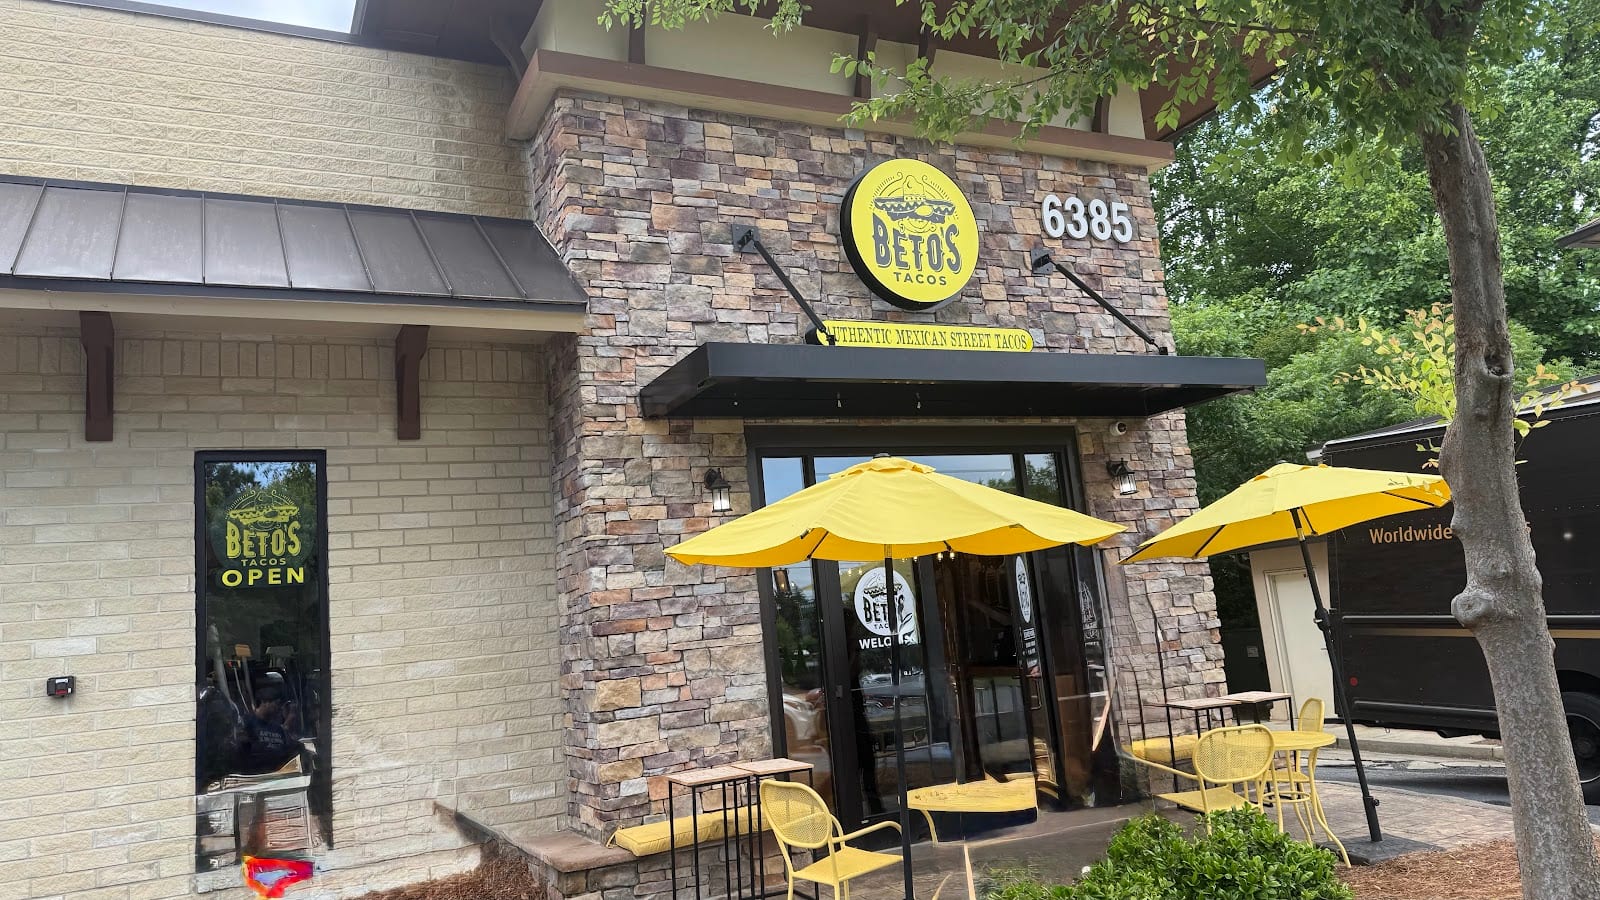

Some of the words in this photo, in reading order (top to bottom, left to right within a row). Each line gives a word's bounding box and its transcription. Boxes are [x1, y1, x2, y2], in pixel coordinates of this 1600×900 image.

[1041, 194, 1133, 244] 6385
[872, 213, 962, 275] BETO'S
[892, 271, 948, 286] TACOS
[895, 328, 947, 346] MEXICAN
[950, 331, 992, 349] STREET
[994, 333, 1027, 350] TACOS
[226, 520, 301, 559] BETO'S
[1369, 524, 1453, 545] Worldwide
[241, 557, 287, 567] TACOS
[221, 566, 305, 587] OPEN
[859, 635, 903, 650] WELC
